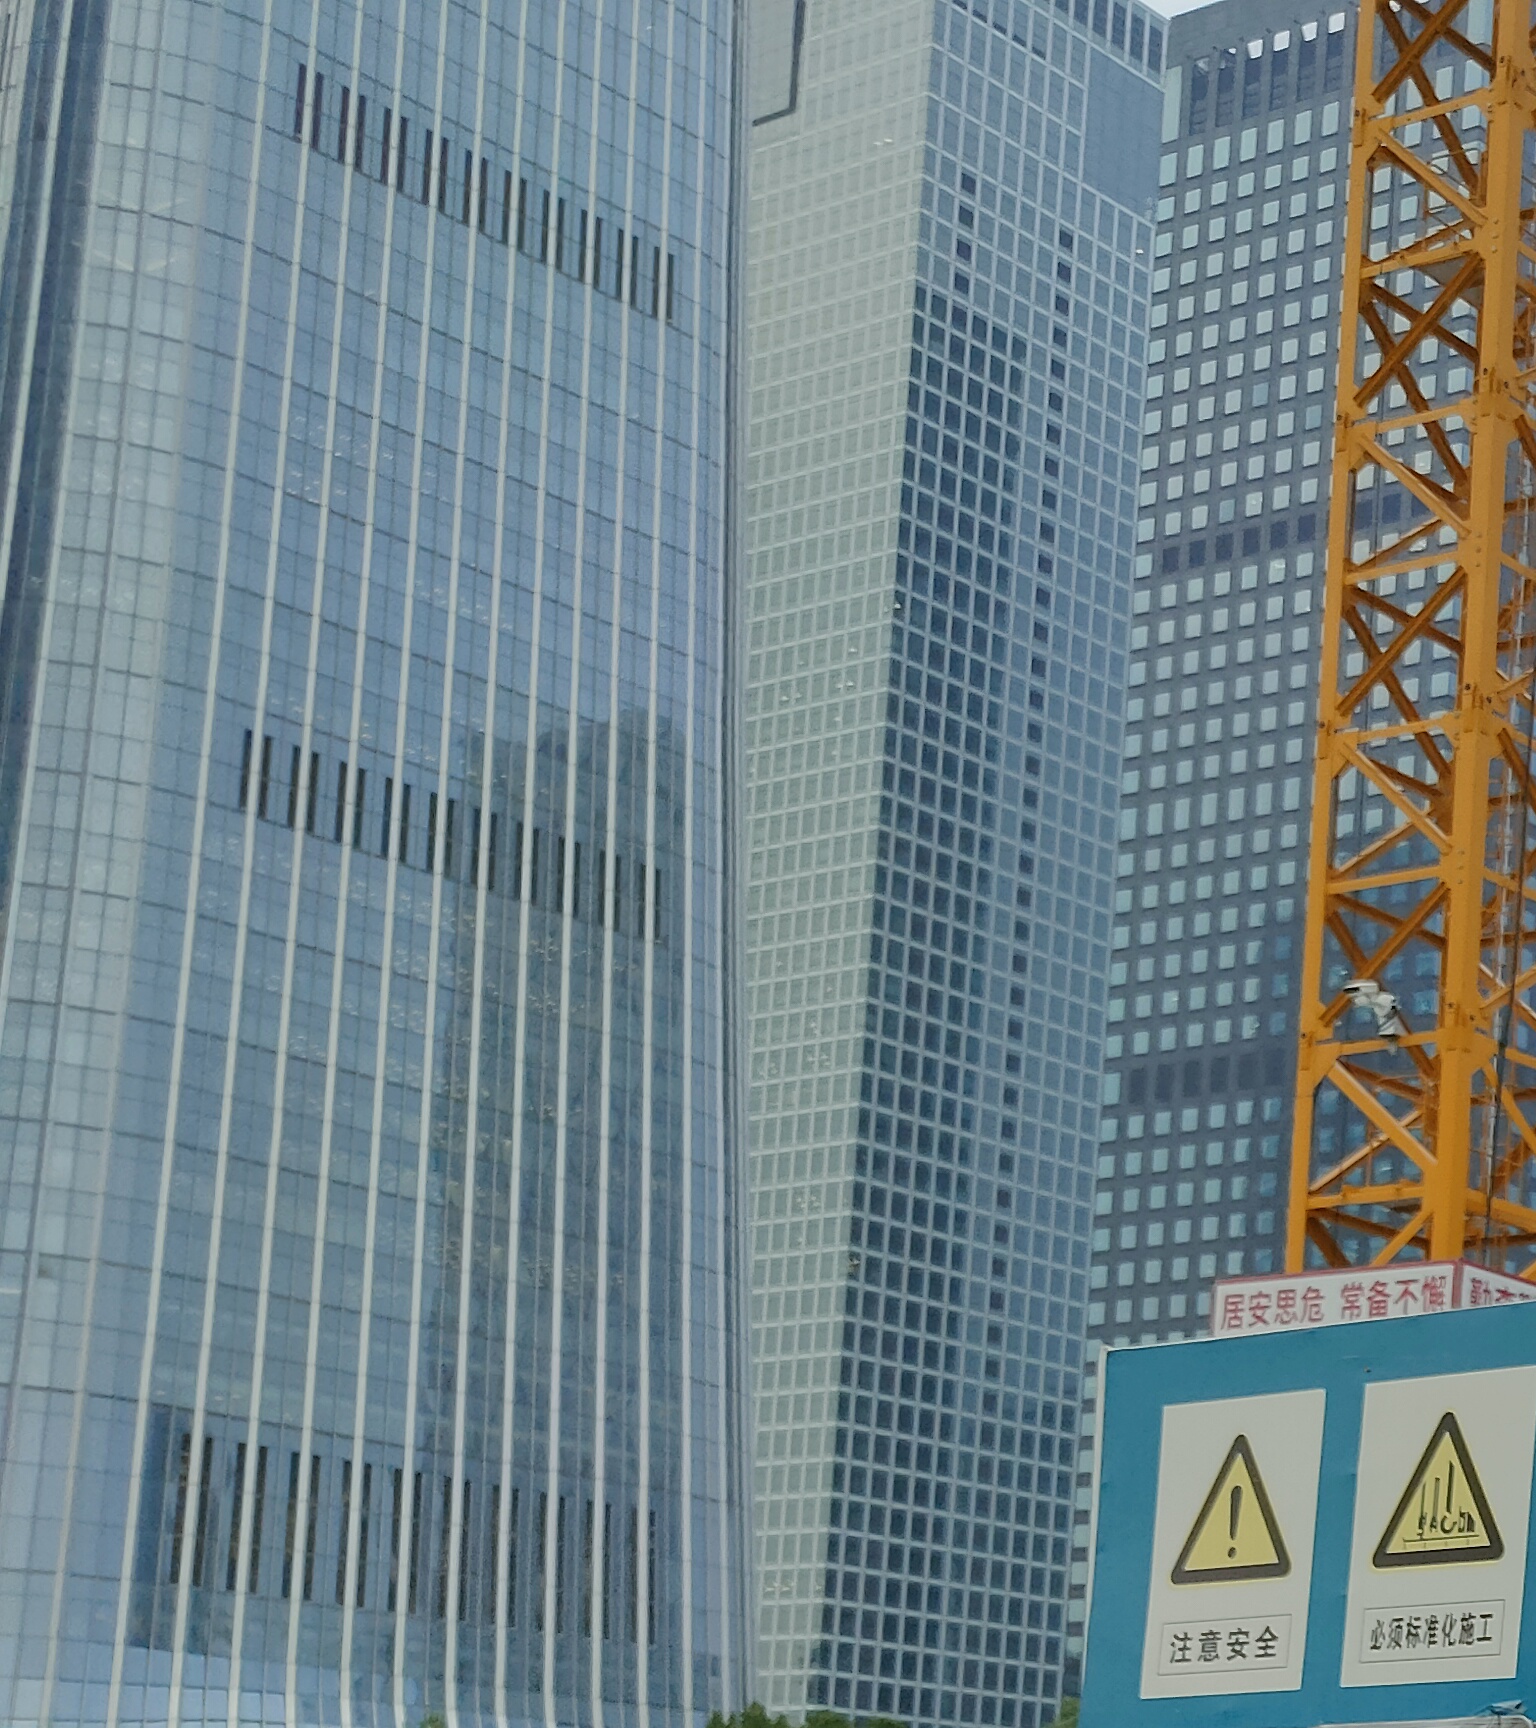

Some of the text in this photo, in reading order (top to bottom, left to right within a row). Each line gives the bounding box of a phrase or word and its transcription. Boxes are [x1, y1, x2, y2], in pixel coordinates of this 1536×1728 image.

[1221, 1275, 1449, 1330] 居安思危 常备不懈
[1168, 1625, 1281, 1665] 注意安全
[1369, 1610, 1494, 1652] 必须标准化施工
